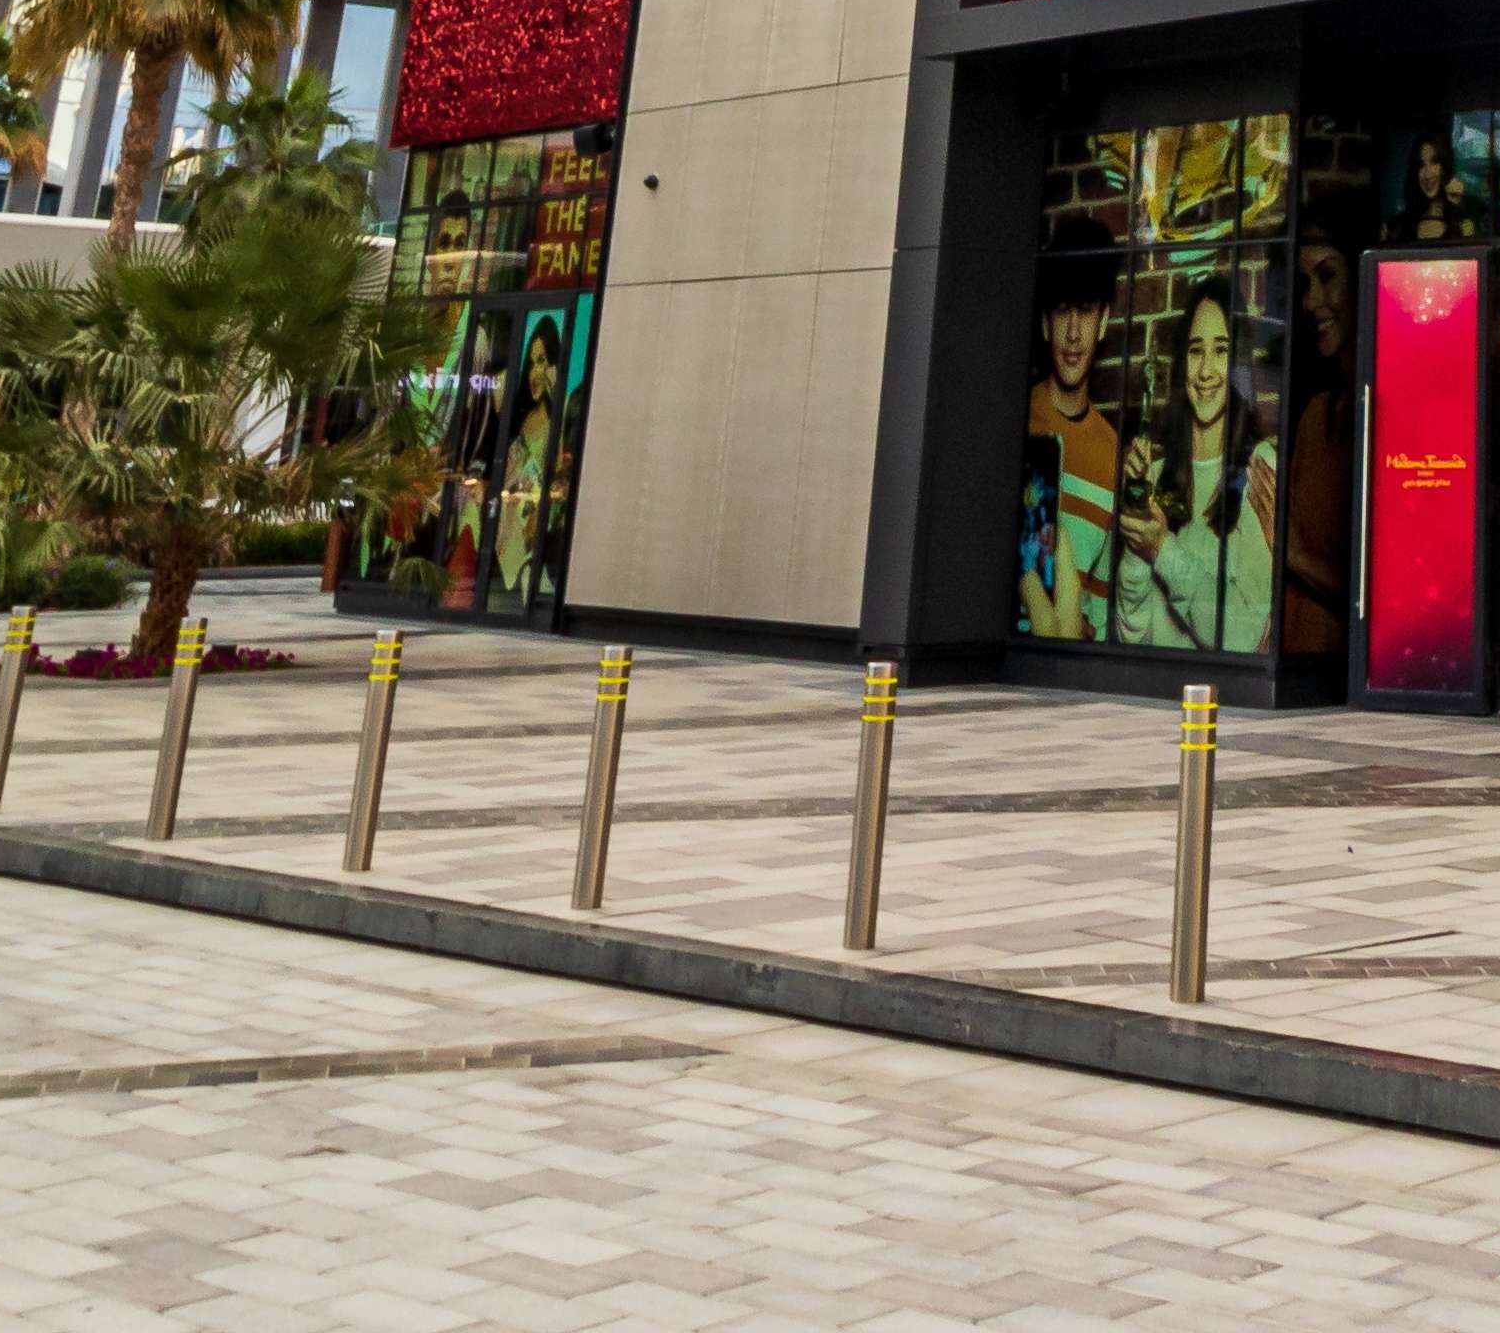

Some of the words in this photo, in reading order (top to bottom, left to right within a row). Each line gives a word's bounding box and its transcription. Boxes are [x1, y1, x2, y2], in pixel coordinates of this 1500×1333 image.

[550, 148, 607, 183] FEEL
[544, 194, 587, 233] THE
[537, 239, 601, 277] FAME
